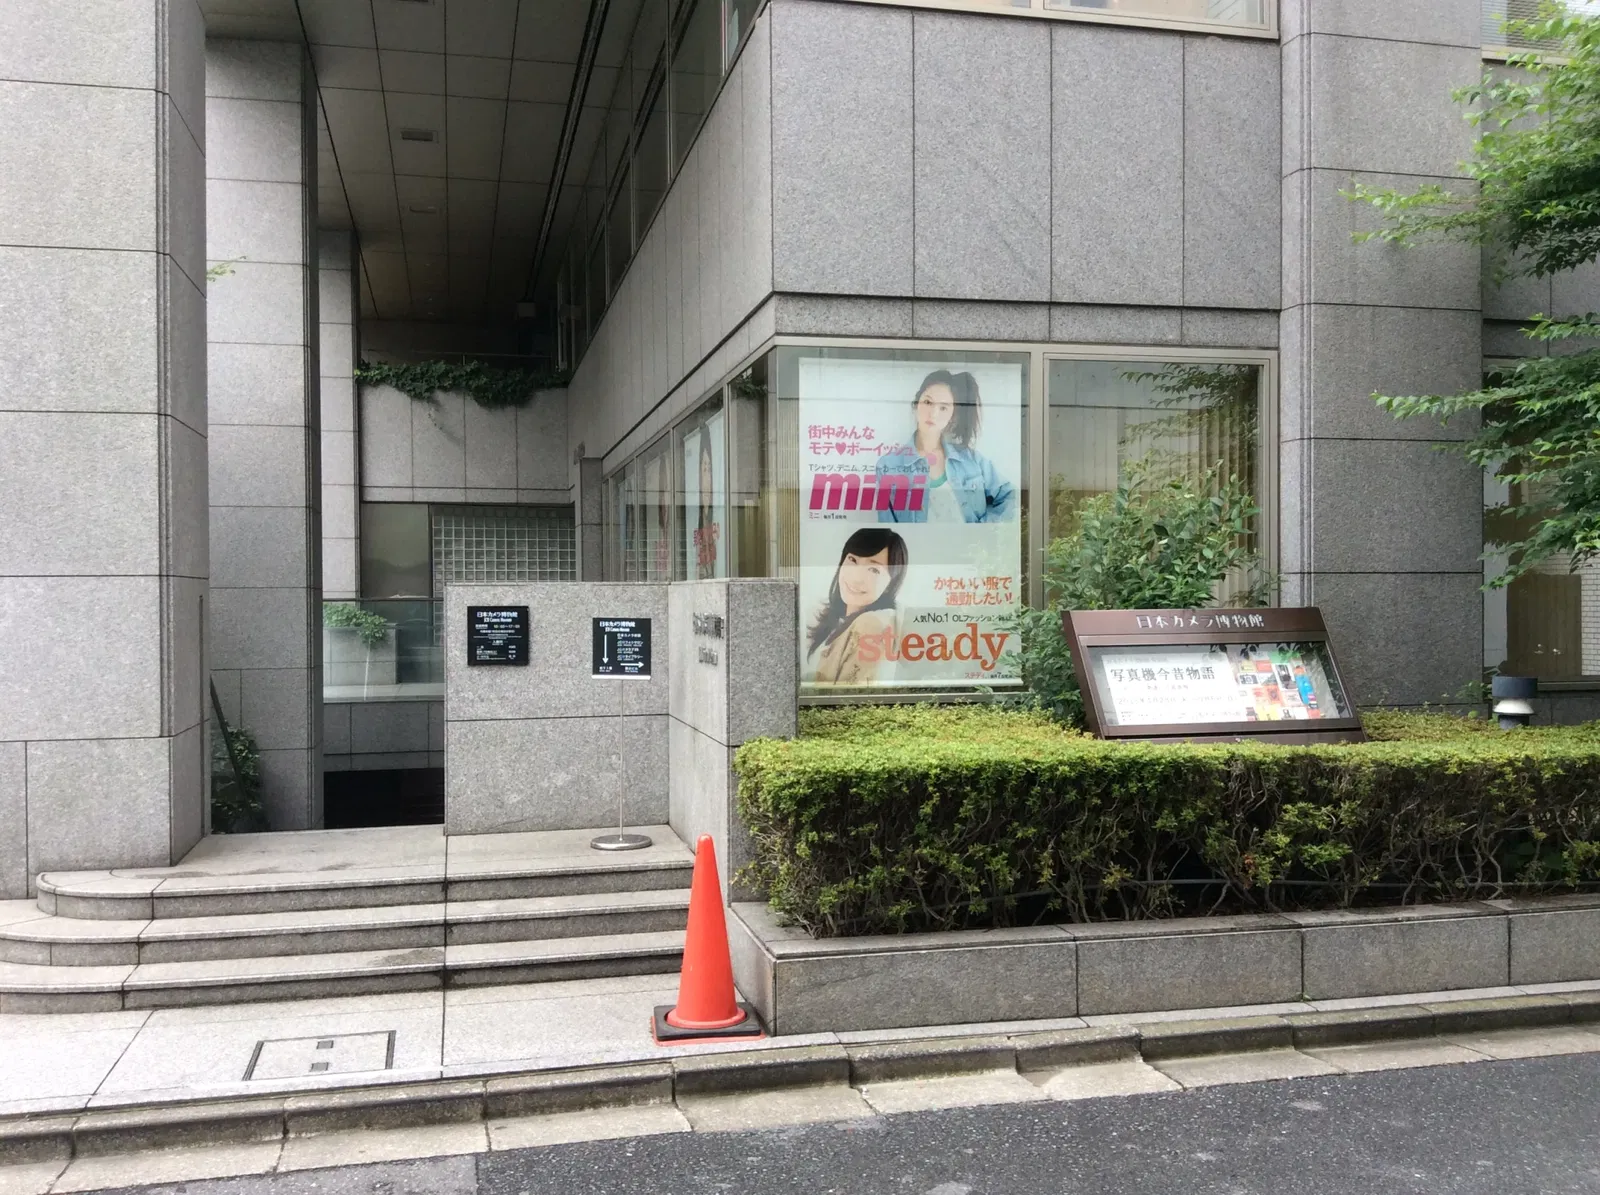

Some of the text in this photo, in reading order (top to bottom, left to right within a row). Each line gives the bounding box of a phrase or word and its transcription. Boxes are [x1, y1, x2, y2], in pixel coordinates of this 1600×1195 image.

[808, 424, 875, 440] 街中みんな
[808, 473, 927, 511] mini
[934, 576, 1012, 590] かわいい服で
[1136, 613, 1265, 629] 日本カメラ博物館
[858, 623, 1010, 671] steady
[1110, 666, 1216, 683] 写真機今昔物語
